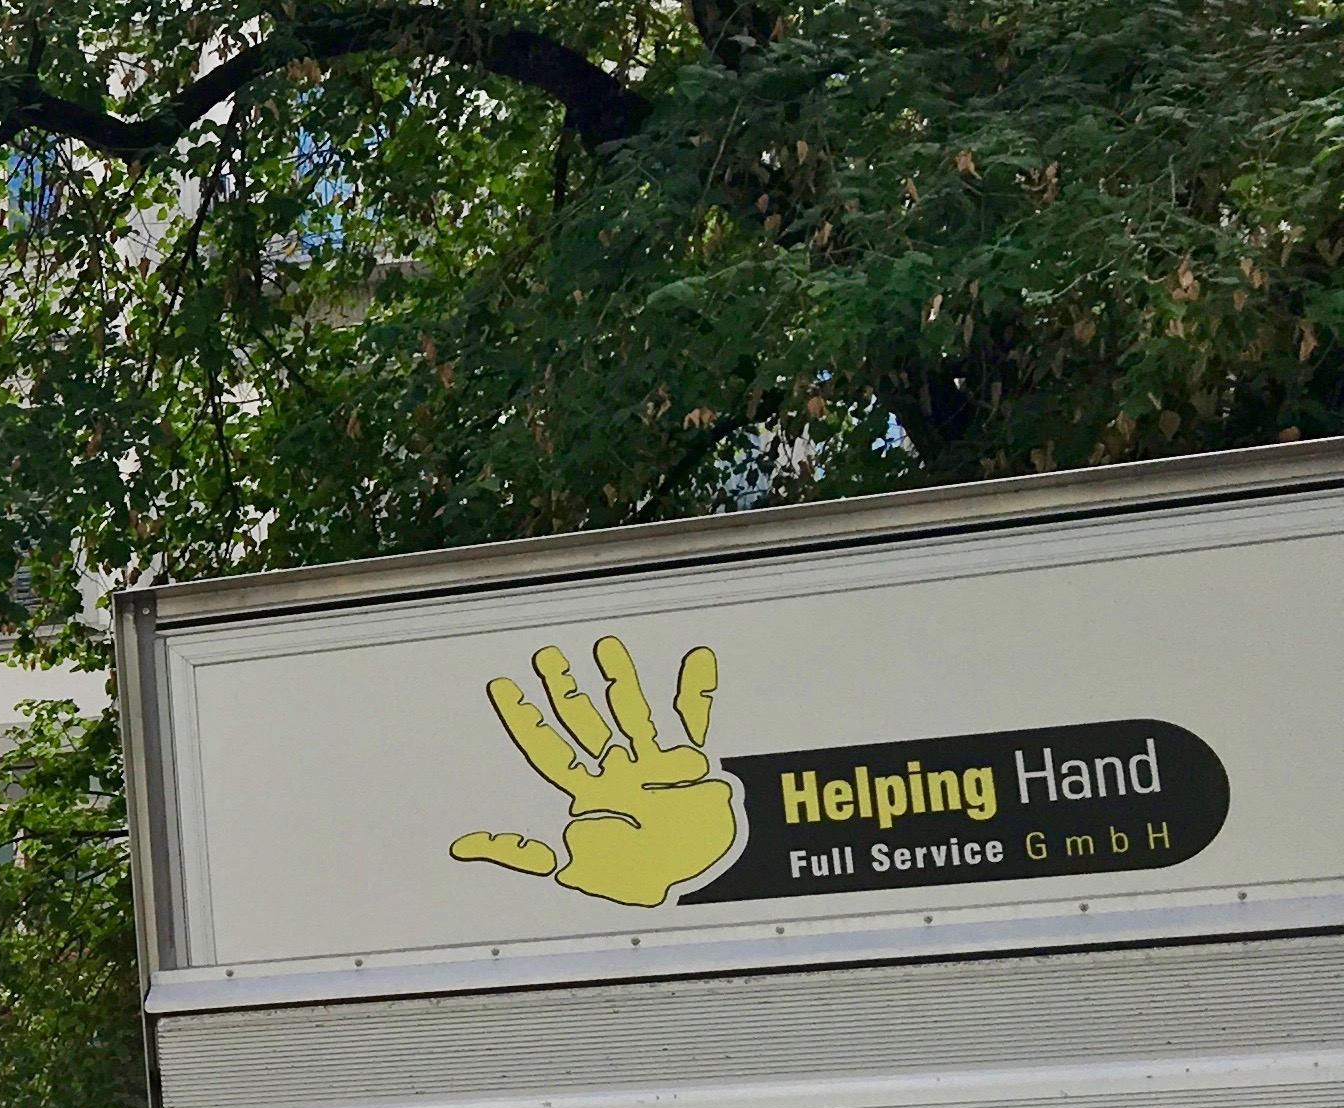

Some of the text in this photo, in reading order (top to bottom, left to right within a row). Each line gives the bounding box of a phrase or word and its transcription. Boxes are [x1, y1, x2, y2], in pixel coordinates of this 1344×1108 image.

[780, 738, 1162, 829] Helping Hand
[789, 845, 854, 878] Full
[871, 837, 1004, 872] Service
